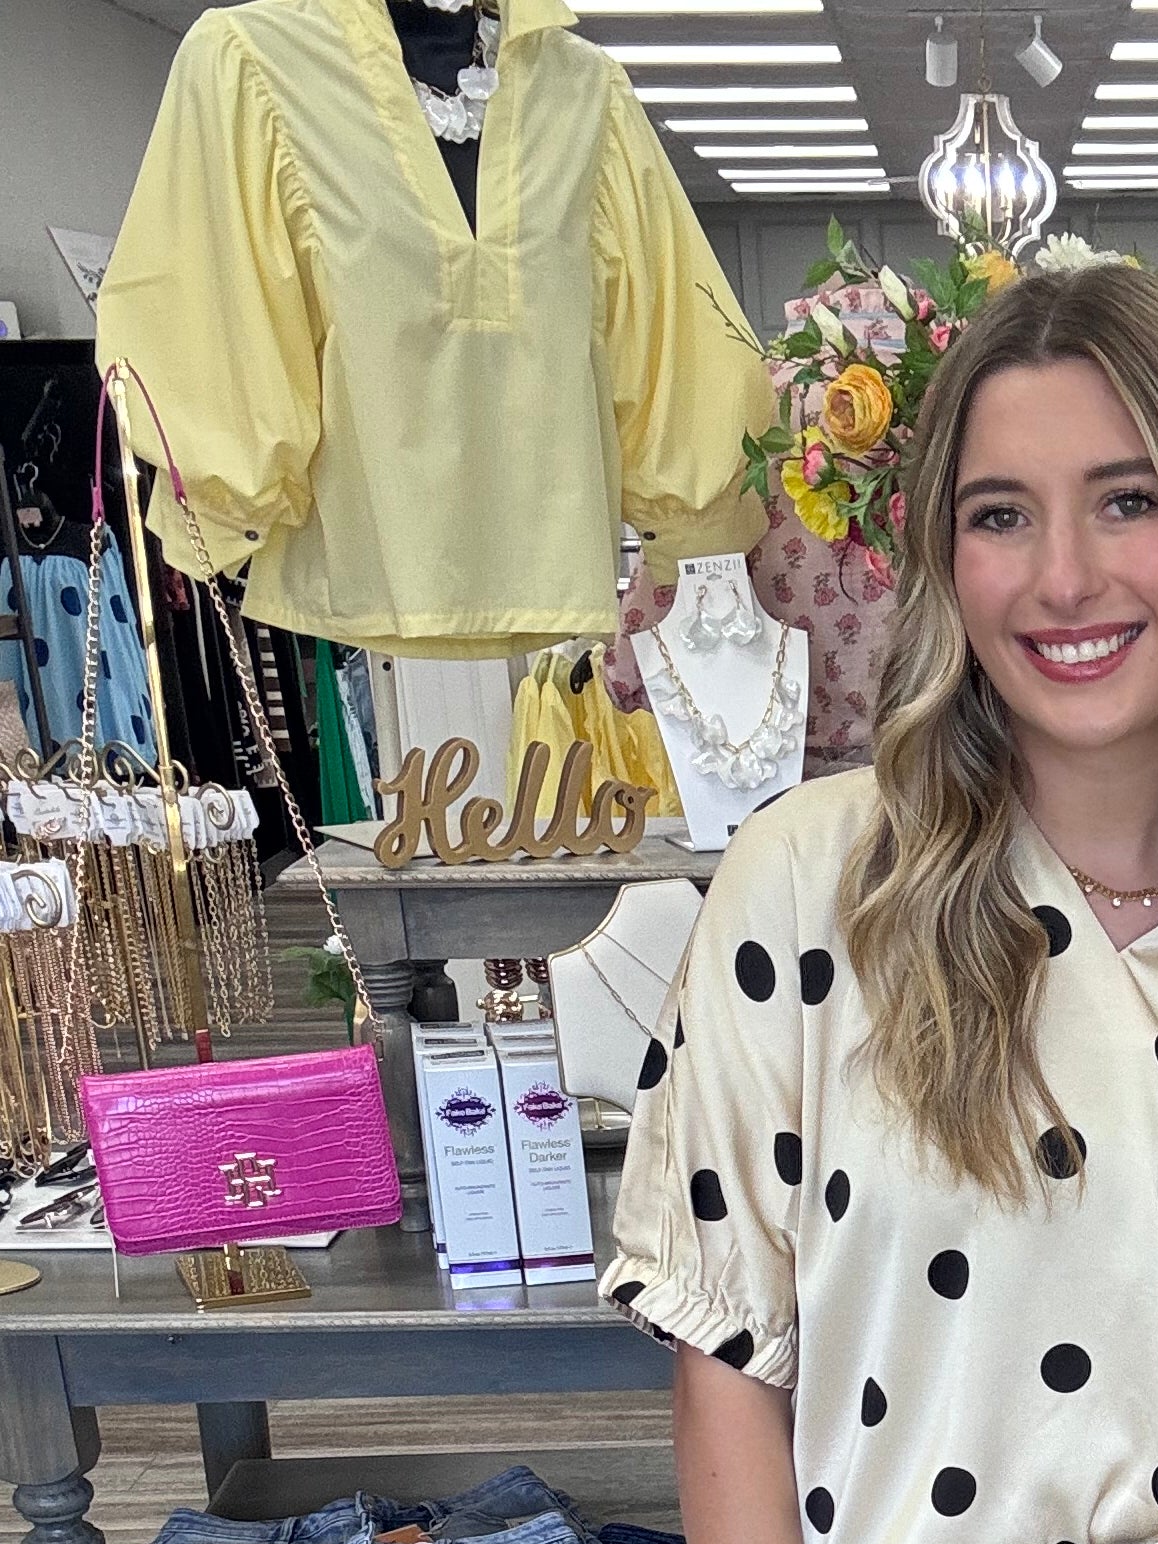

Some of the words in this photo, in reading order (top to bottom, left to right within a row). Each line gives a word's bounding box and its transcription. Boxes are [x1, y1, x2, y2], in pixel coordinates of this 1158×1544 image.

[697, 560, 741, 575] ZENZII
[372, 737, 657, 869] Hello
[521, 1138, 571, 1150] Flawless
[444, 1145, 495, 1157] Flawless
[529, 1152, 567, 1164] Darker
